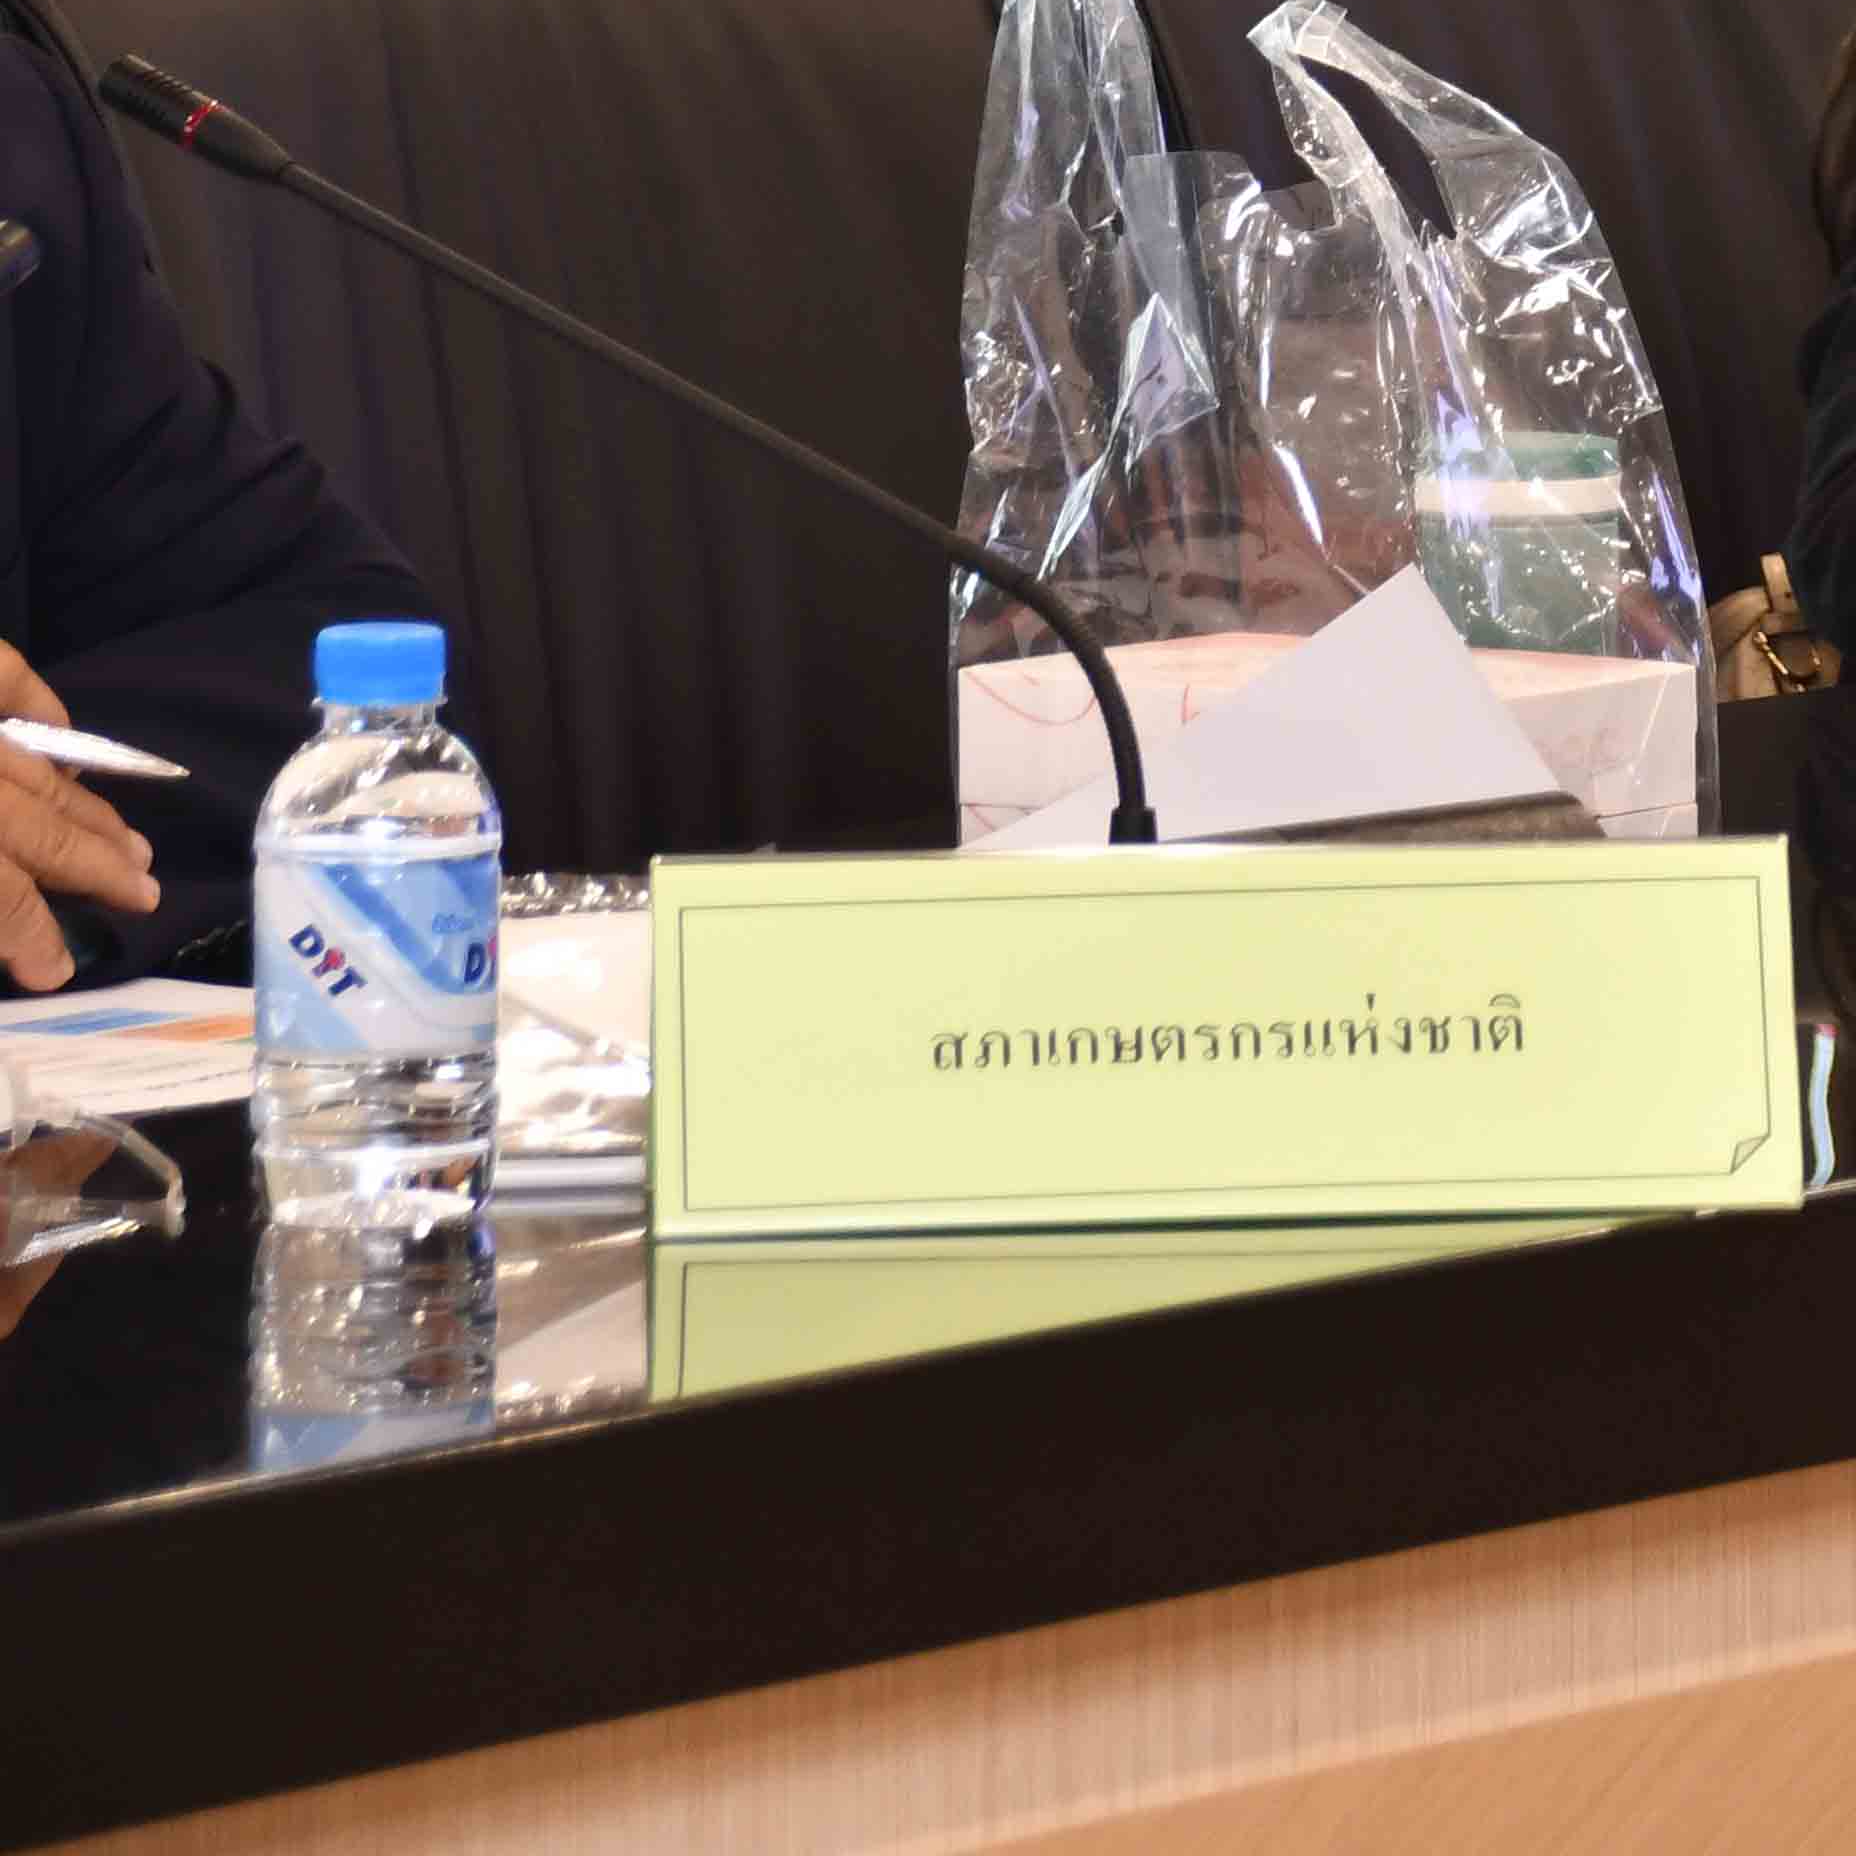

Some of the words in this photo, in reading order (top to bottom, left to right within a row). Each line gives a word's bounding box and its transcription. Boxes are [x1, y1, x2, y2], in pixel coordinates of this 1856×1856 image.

[931, 991, 1525, 1070] สภาเกษตรกรแห่งชาติ
